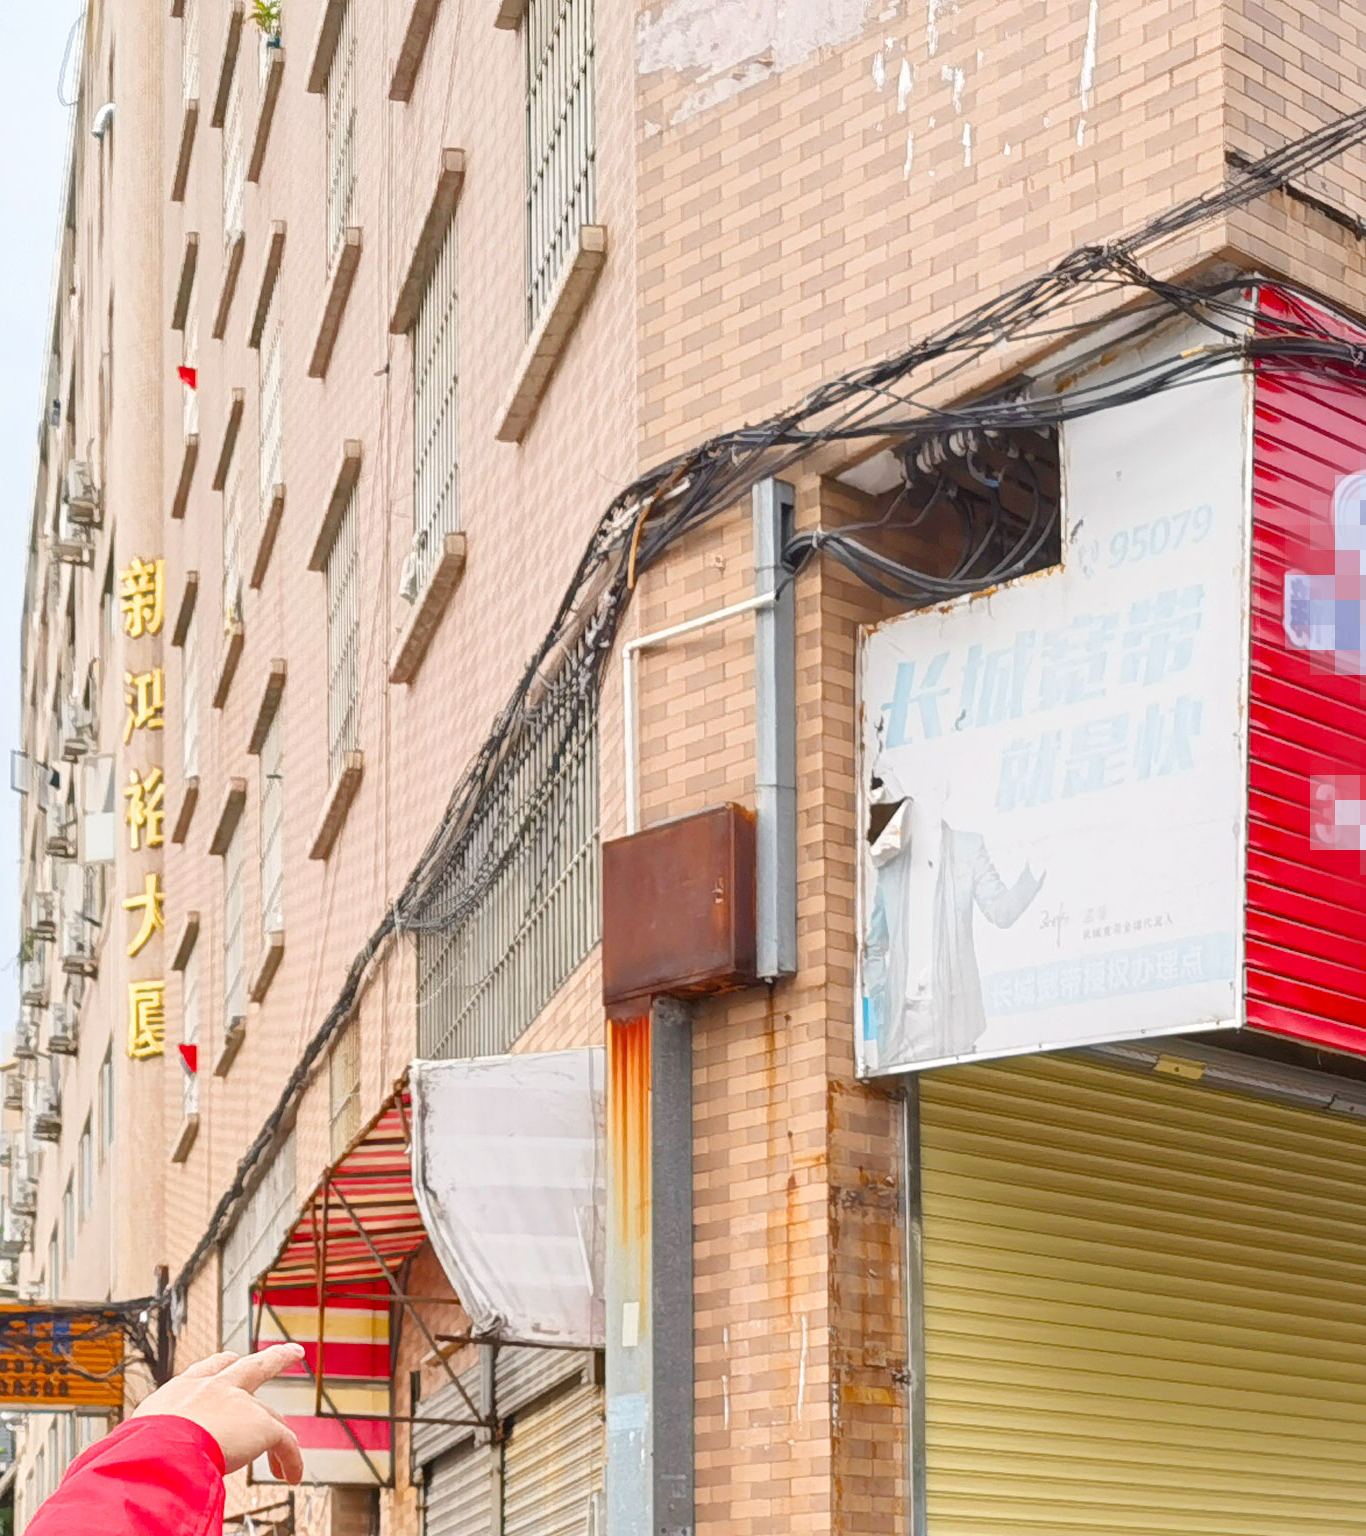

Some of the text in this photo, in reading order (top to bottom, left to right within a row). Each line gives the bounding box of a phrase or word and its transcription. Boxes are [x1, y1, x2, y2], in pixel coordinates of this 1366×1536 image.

[1109, 504, 1213, 569] 95079
[882, 582, 1206, 749] 长城宽带
[995, 694, 1203, 814] 就是快
